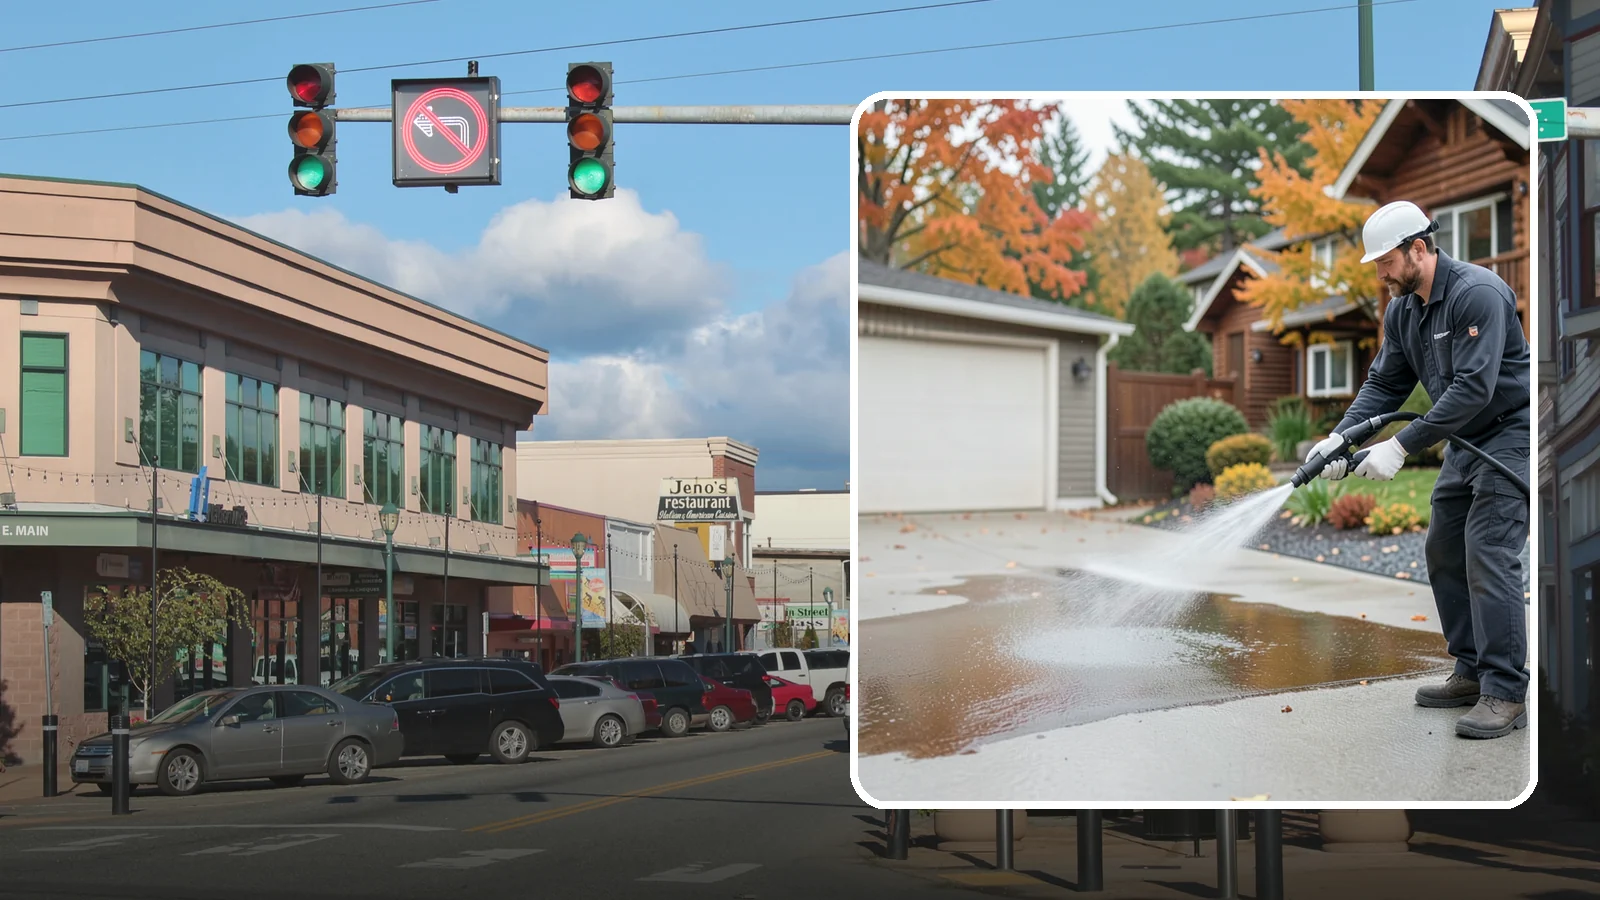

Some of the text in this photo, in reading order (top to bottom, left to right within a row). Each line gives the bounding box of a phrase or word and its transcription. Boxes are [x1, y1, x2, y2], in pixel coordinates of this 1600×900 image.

[670, 480, 727, 494] Jeno's
[665, 497, 731, 509] restaurant
[658, 510, 681, 519] Italian
[686, 510, 714, 519] American
[715, 510, 737, 519] Cuisine
[2, 525, 49, 536] E. MAIN
[797, 607, 828, 616] Street
